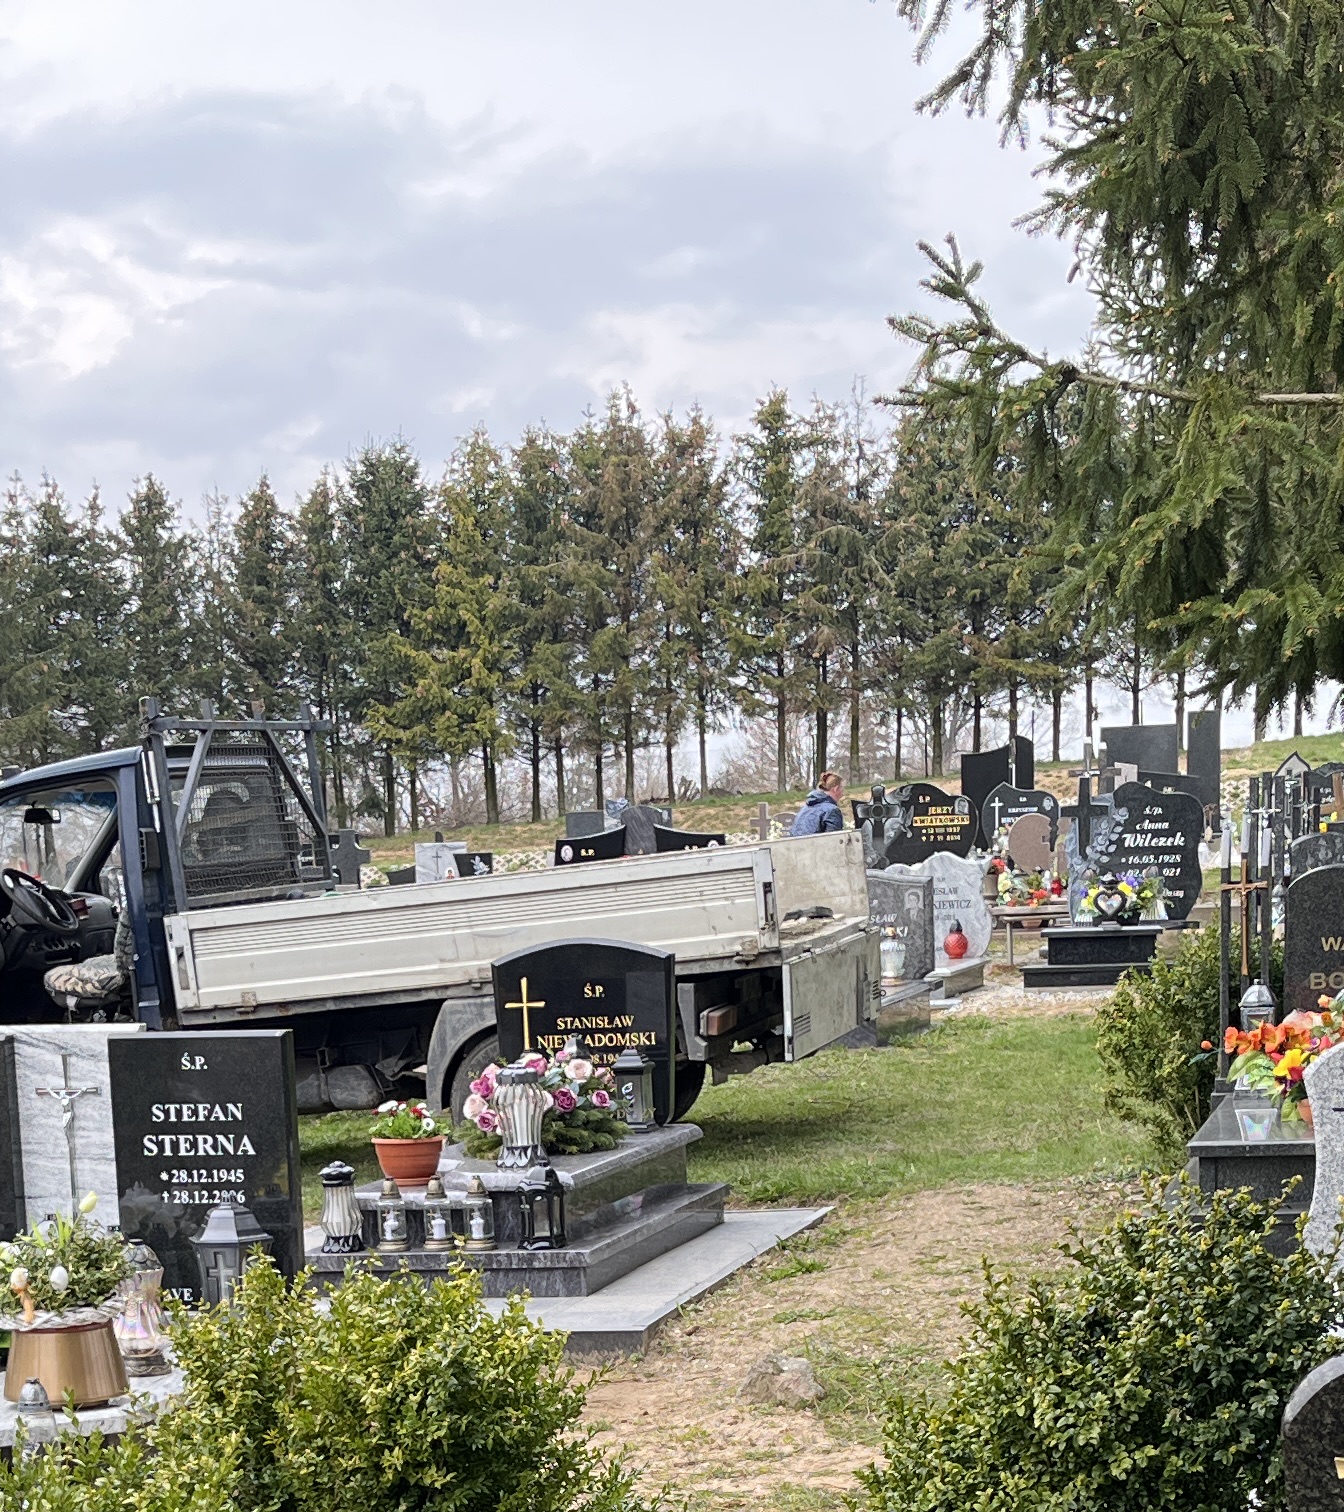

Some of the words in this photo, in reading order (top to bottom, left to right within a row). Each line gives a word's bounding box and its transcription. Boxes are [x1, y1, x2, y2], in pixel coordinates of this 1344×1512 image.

[928, 806, 953, 815] JERZY
[1136, 819, 1170, 830] Anna
[556, 1015, 635, 1030] STANISŁAW
[181, 1051, 208, 1070] Ś.P.
[151, 1103, 243, 1122] STEFAN
[142, 1134, 256, 1157] STERNA
[171, 1168, 245, 1184] 28.12.1945
